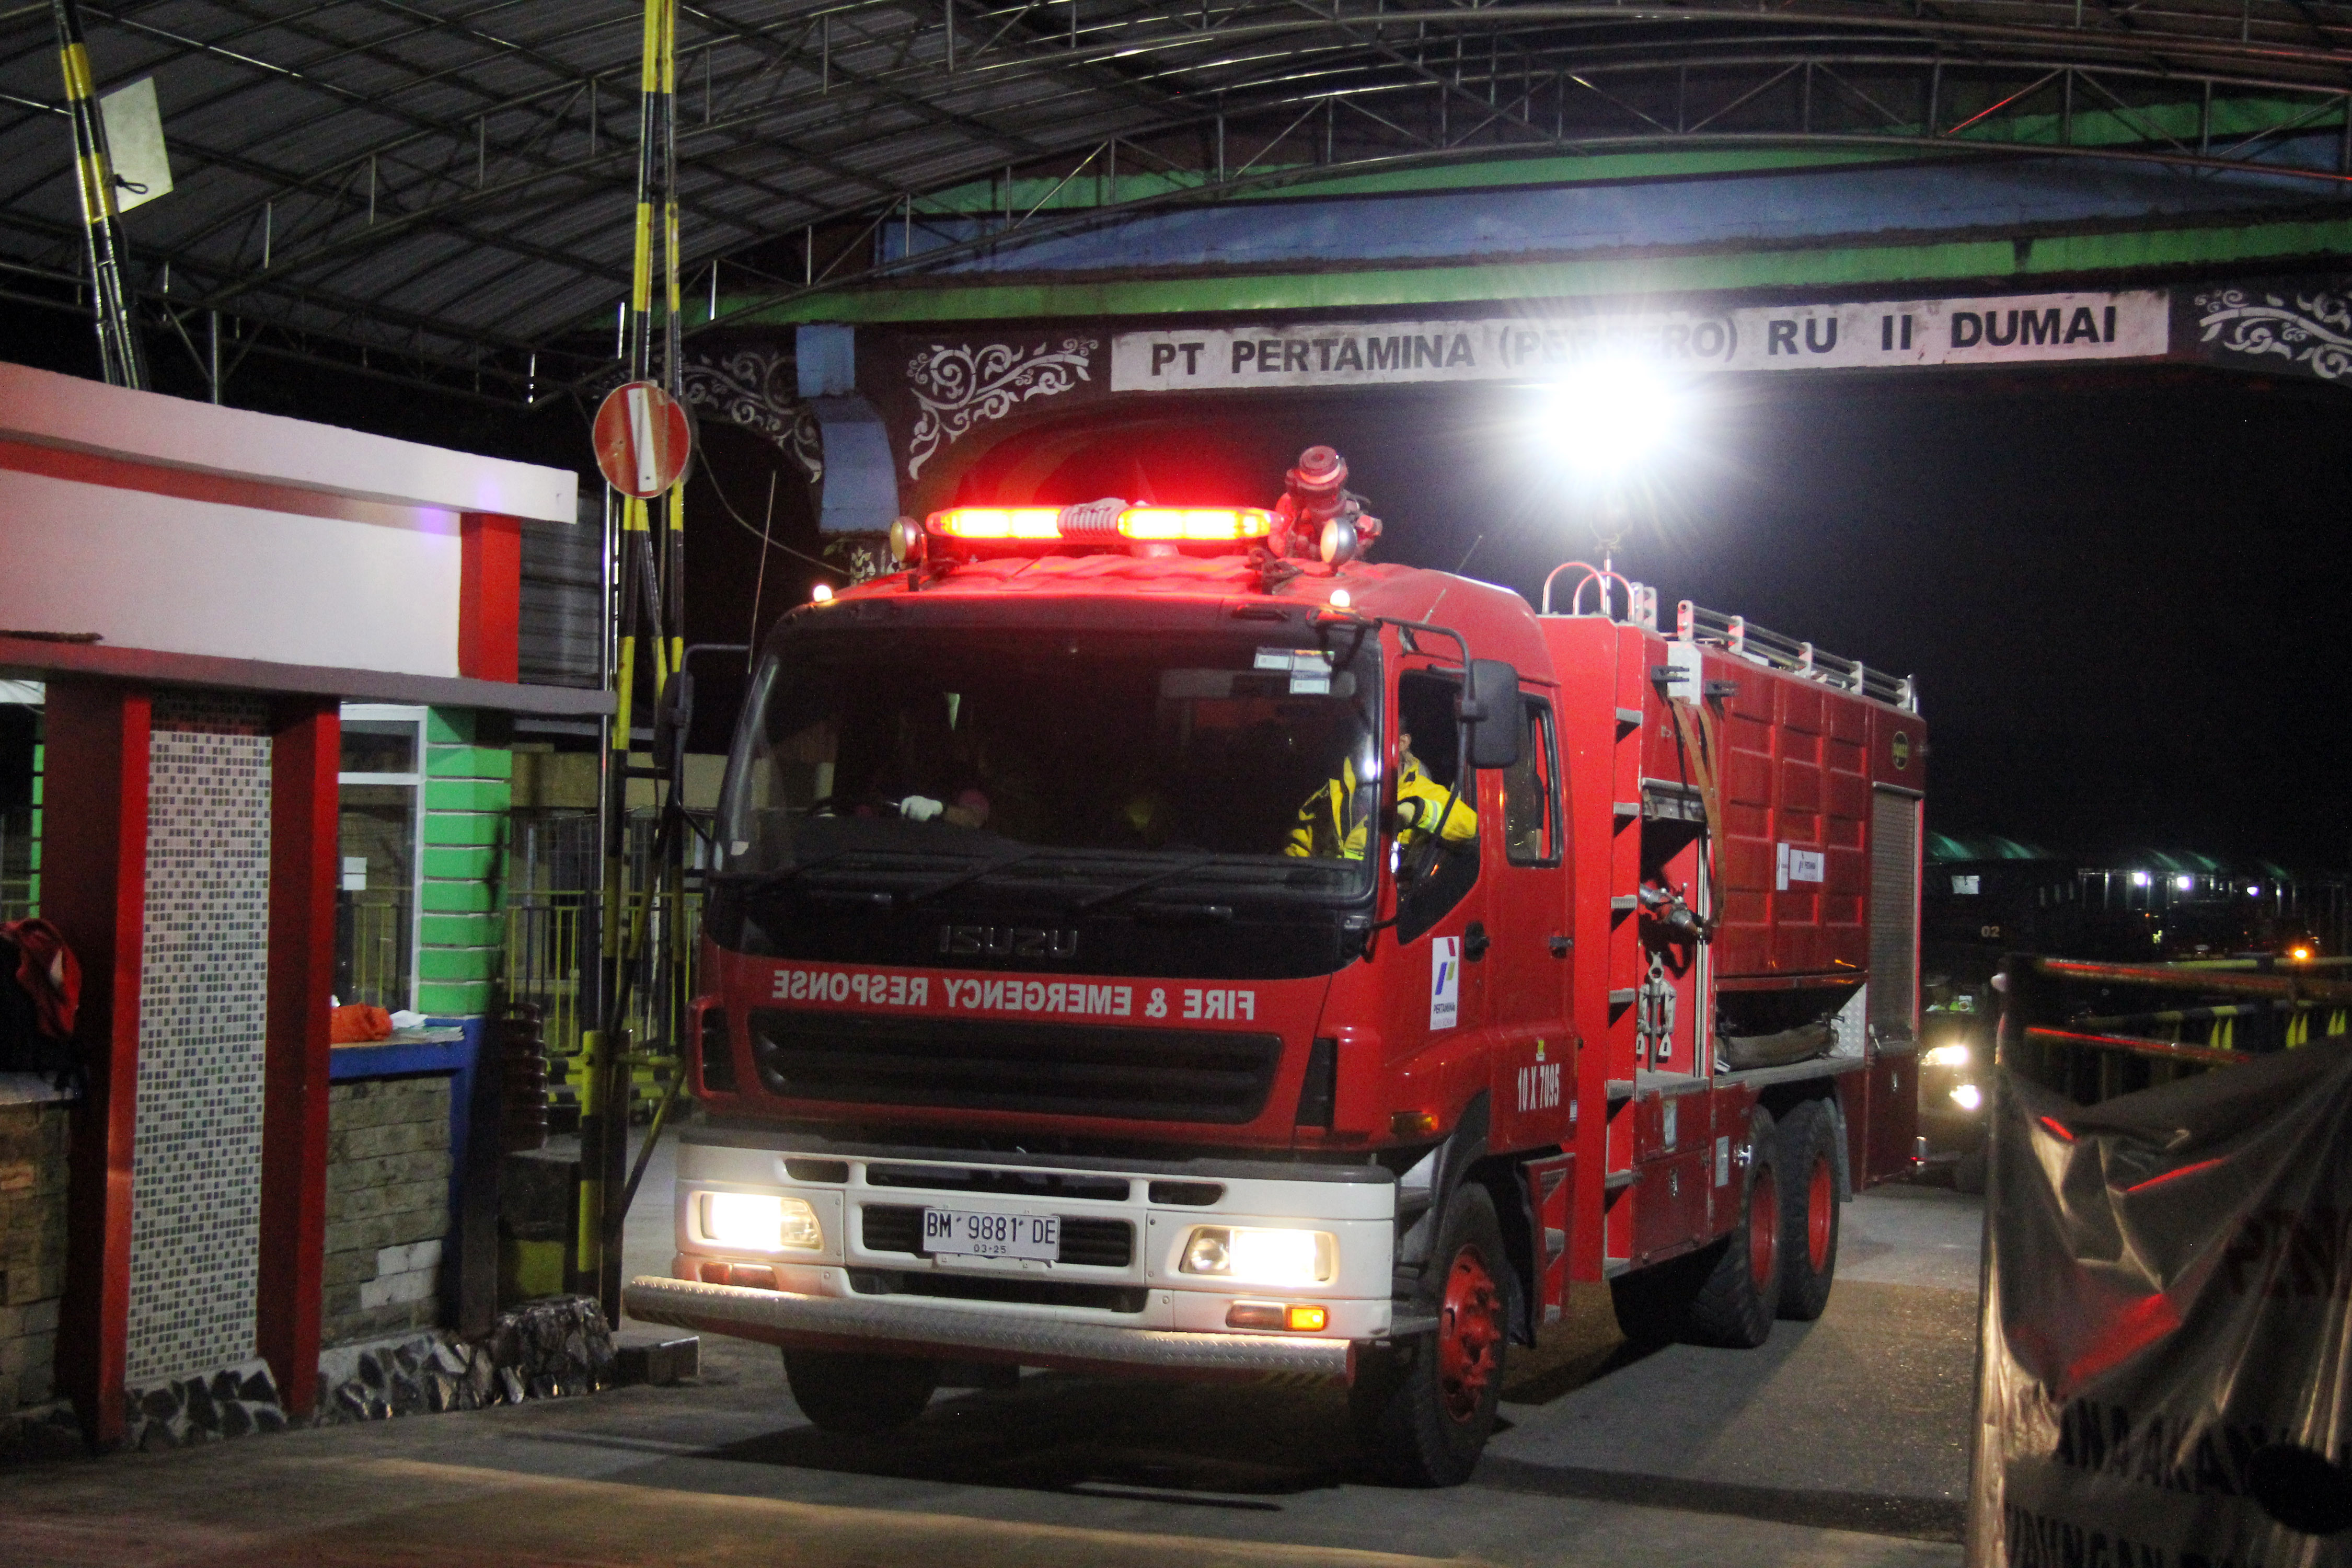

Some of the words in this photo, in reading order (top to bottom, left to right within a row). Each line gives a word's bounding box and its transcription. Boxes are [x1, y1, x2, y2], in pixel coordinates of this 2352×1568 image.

[1151, 342, 1205, 377] PT
[1231, 333, 1476, 374] PERTAMINA
[1767, 316, 1838, 355] RU
[1882, 315, 1912, 351] II
[1950, 306, 2116, 349] DUMAI
[940, 925, 1079, 958] ISUZU
[1980, 925, 2001, 938] 02
[1517, 1066, 1528, 1112] 10
[1539, 1063, 1560, 1109] 7095
[926, 1212, 952, 1238] BM
[968, 1215, 1017, 1242] 9881
[1032, 1218, 1056, 1244] DE
